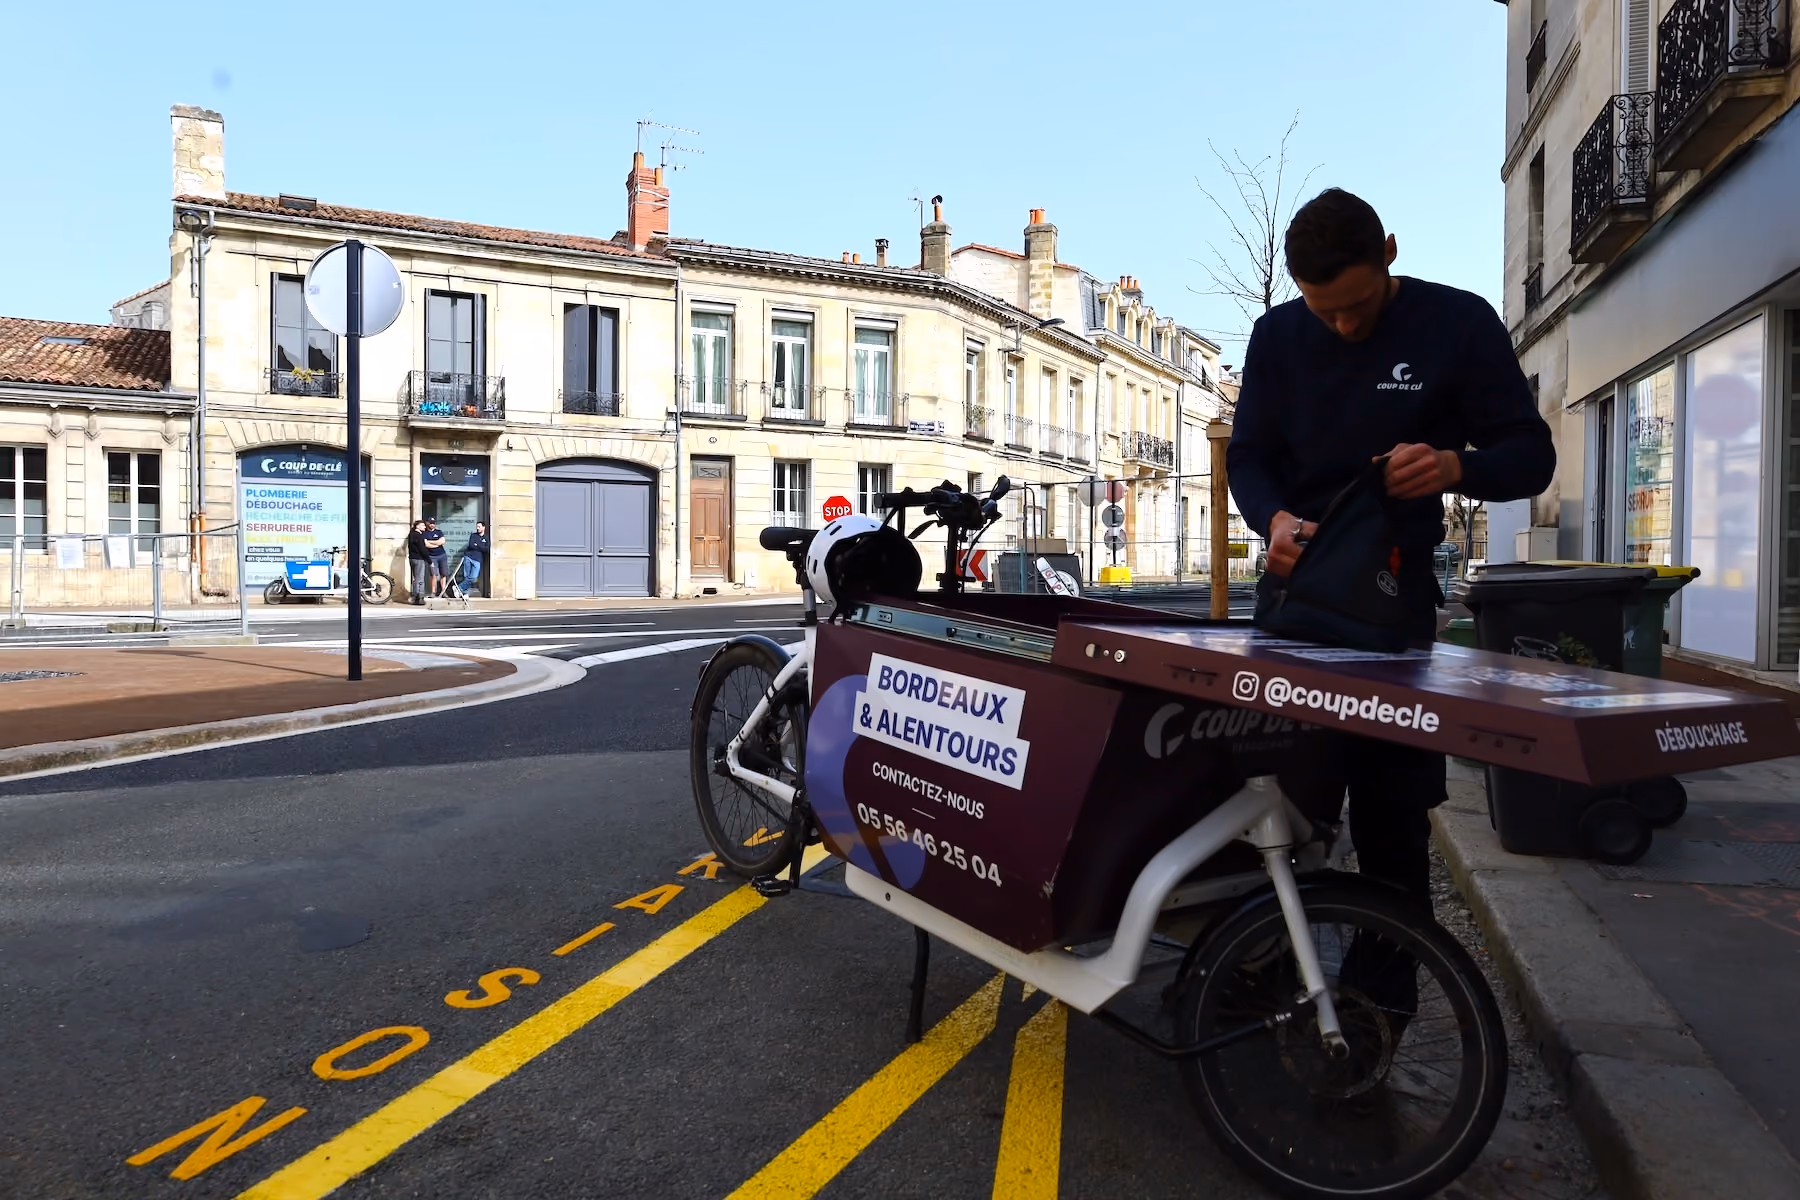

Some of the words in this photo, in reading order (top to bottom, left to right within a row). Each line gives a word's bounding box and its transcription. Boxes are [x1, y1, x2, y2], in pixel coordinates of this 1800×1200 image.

[279, 461, 307, 471] COUP
[309, 462, 322, 472] DE
[324, 461, 343, 472] CLÉ
[246, 489, 308, 499] PLOMBERIE
[246, 499, 322, 511] DÉBOUCHAGE
[246, 511, 312, 522] RECHERCHE
[825, 505, 850, 517] STOP
[246, 523, 312, 533] SERRURERIE
[877, 664, 1008, 724] BORDEAUX
[1264, 676, 1440, 733] @coupdecle
[859, 702, 873, 729] &
[876, 708, 1018, 776] ALENTOURS
[1190, 708, 1262, 740] COUP
[1654, 720, 1749, 753] DÉBOUCHAGE
[872, 761, 985, 820] CONTACTEZ-NOUS
[856, 802, 881, 830] 05
[884, 814, 909, 843] 56
[911, 827, 938, 856] 46
[940, 840, 968, 872] 25
[971, 854, 1003, 888] 04
